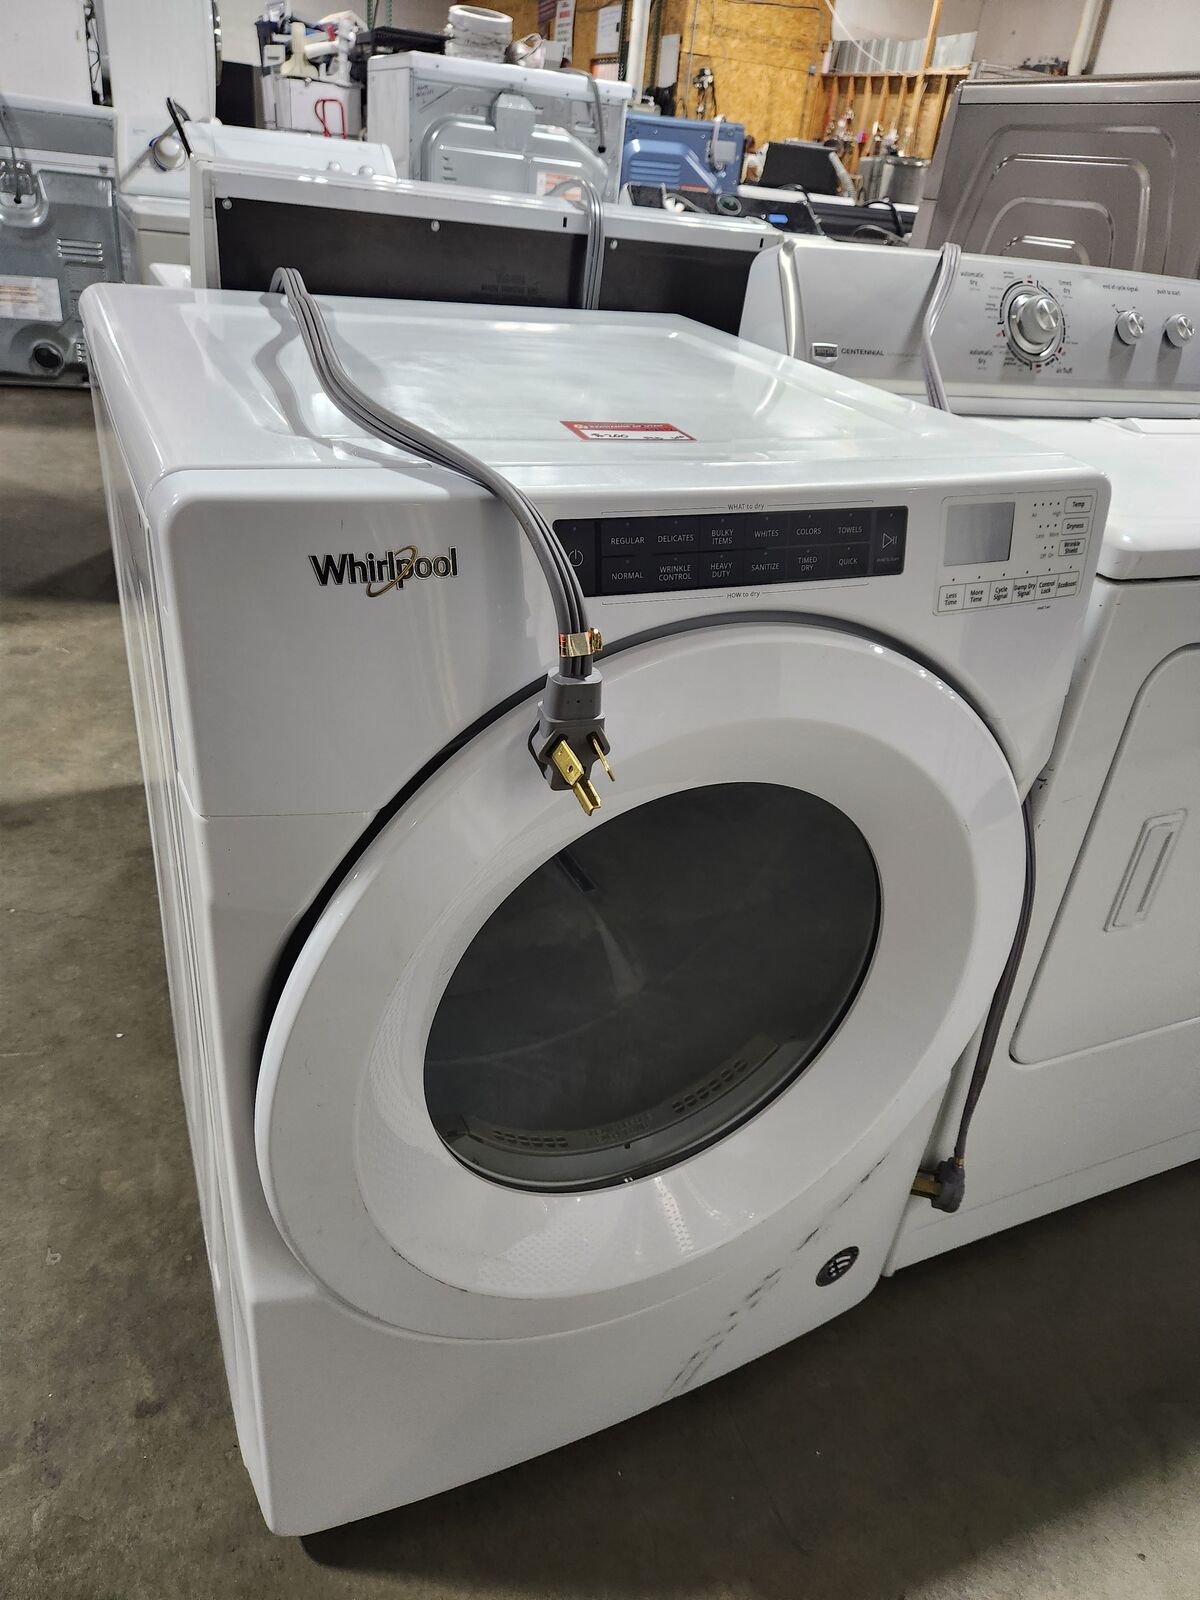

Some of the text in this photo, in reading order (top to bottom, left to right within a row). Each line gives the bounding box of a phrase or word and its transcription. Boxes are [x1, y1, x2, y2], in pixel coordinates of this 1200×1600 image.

[841, 347, 884, 356] CENTENNIAL
[727, 503, 747, 511] WHAT
[754, 503, 765, 511] dry
[1072, 501, 1085, 509] Temp
[711, 528, 734, 538] BULKY
[754, 529, 780, 538] WHITES
[796, 528, 822, 536] COLORS
[837, 526, 863, 534] TOWELS
[610, 536, 645, 546] REGULAR
[657, 534, 695, 544] DELICATES
[712, 536, 733, 545] ITEMS
[798, 556, 818, 564] TIMED
[838, 557, 859, 567] QUICK
[308, 546, 458, 590] Whirlpool
[659, 564, 692, 574] WRINKLE
[710, 562, 733, 571] HEAVY
[751, 562, 780, 572] SANITIZE
[801, 564, 814, 572] DRY
[611, 571, 644, 580] NORMAL
[658, 572, 692, 582] CONTROL
[712, 569, 731, 578] DUTY
[1013, 582, 1036, 592] Damp Dry
[1038, 580, 1055, 588] Control
[1057, 580, 1077, 589] EcoBoost
[994, 586, 1008, 594] Cycle
[1017, 589, 1031, 598] Signal
[750, 591, 761, 599] dry
[970, 595, 983, 603] Time
[993, 592, 1009, 601] Signal
